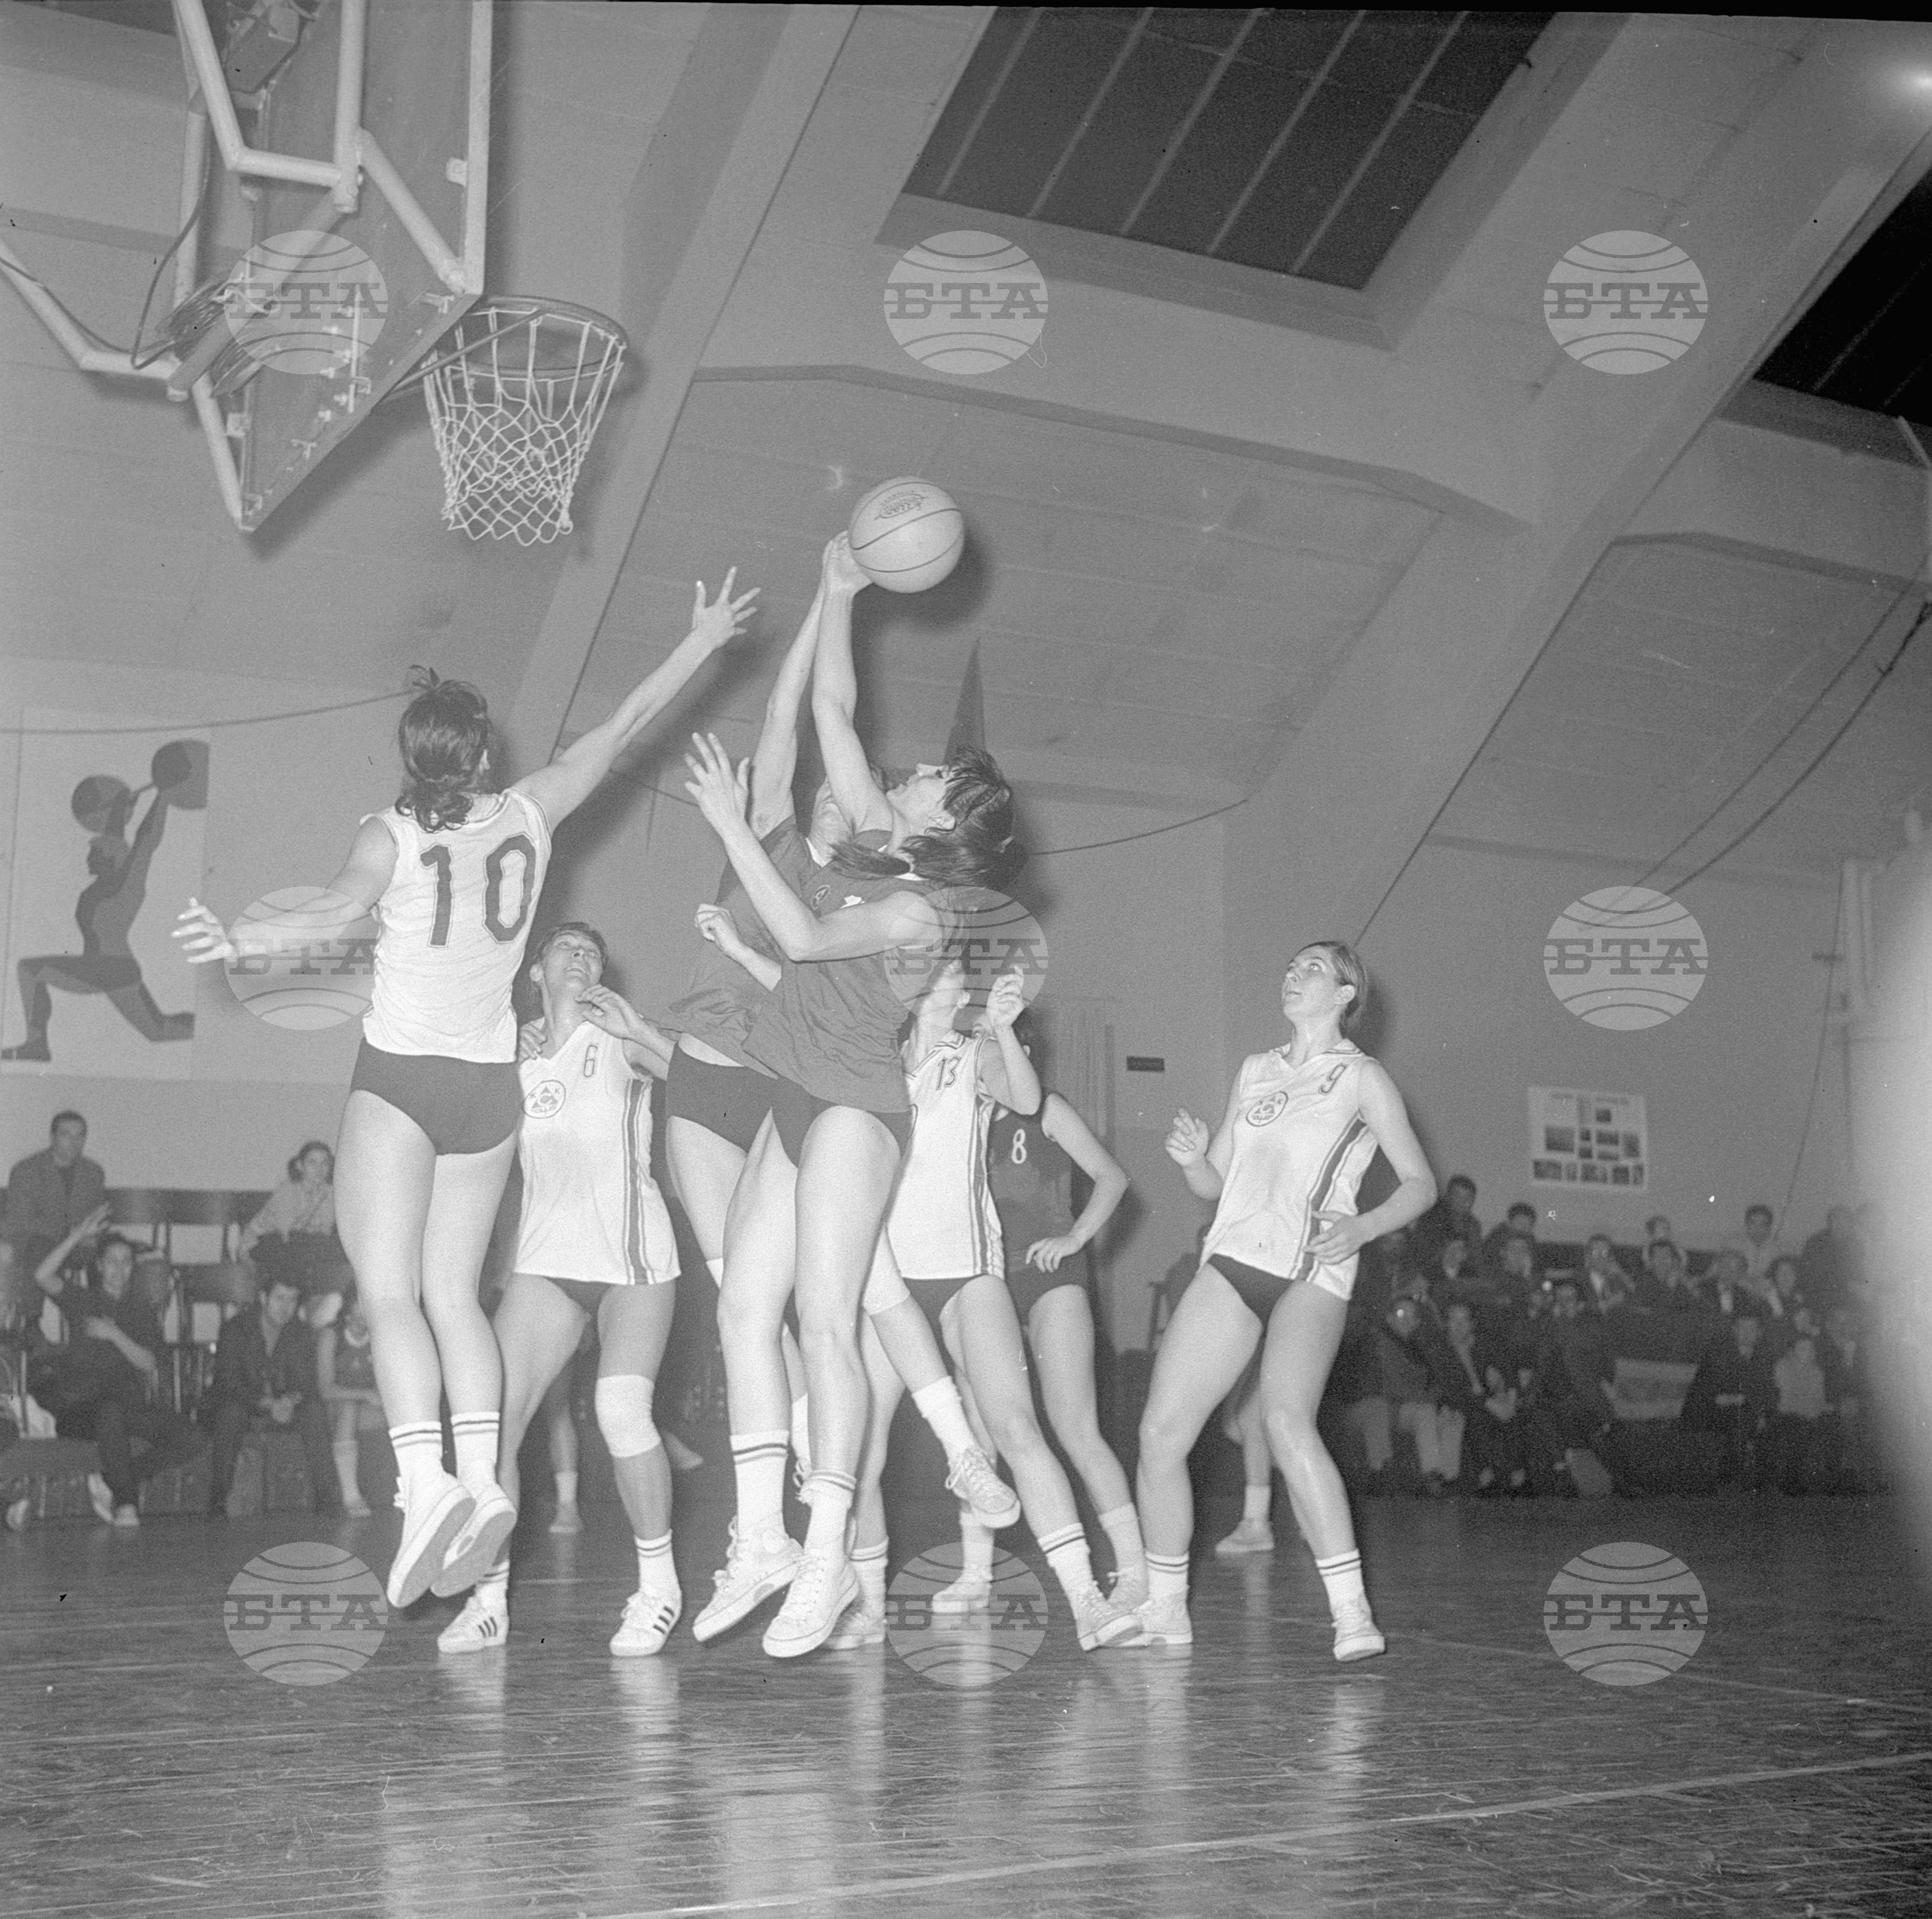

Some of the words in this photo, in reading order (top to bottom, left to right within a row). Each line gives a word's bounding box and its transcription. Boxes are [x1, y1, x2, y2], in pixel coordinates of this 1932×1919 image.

[418, 831, 537, 948] 10
[582, 1042, 598, 1078] 6
[936, 1056, 961, 1090] 13
[1318, 1064, 1348, 1096] 9
[1011, 1129, 1027, 1164] 8
